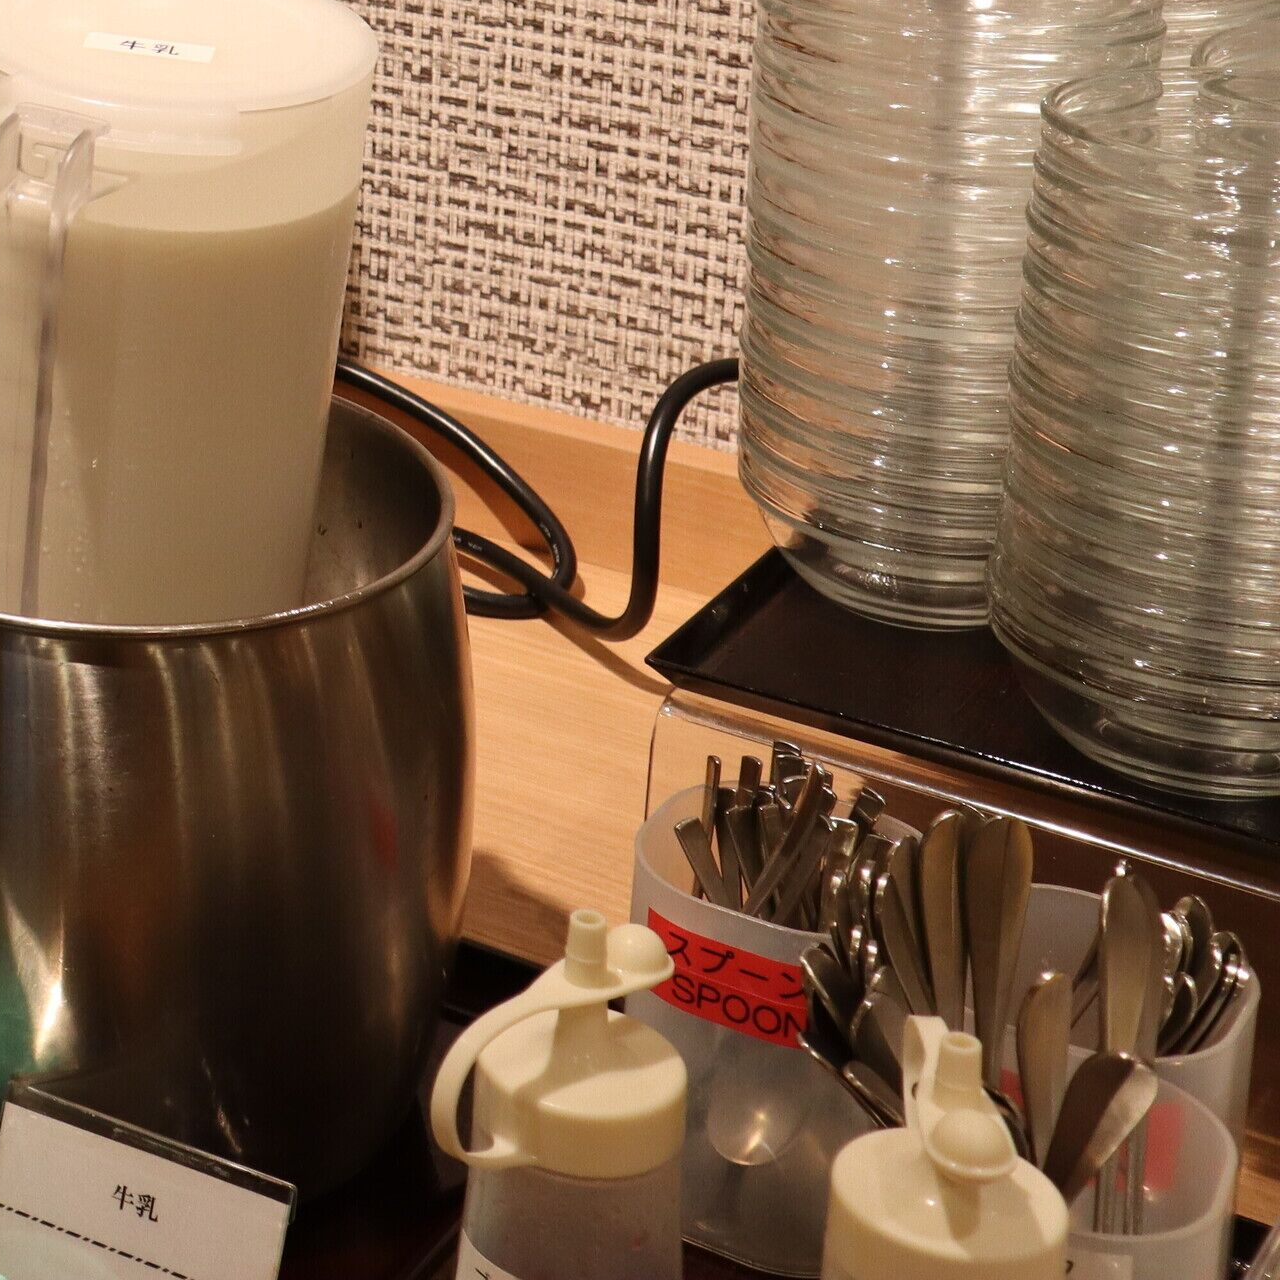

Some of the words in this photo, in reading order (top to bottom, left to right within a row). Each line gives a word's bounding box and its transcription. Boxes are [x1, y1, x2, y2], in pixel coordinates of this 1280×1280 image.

[120, 39, 180, 56] 牛乳
[668, 931, 809, 1000] スプーン
[670, 973, 809, 1039] SPOON
[111, 1184, 159, 1223] 牛乳
